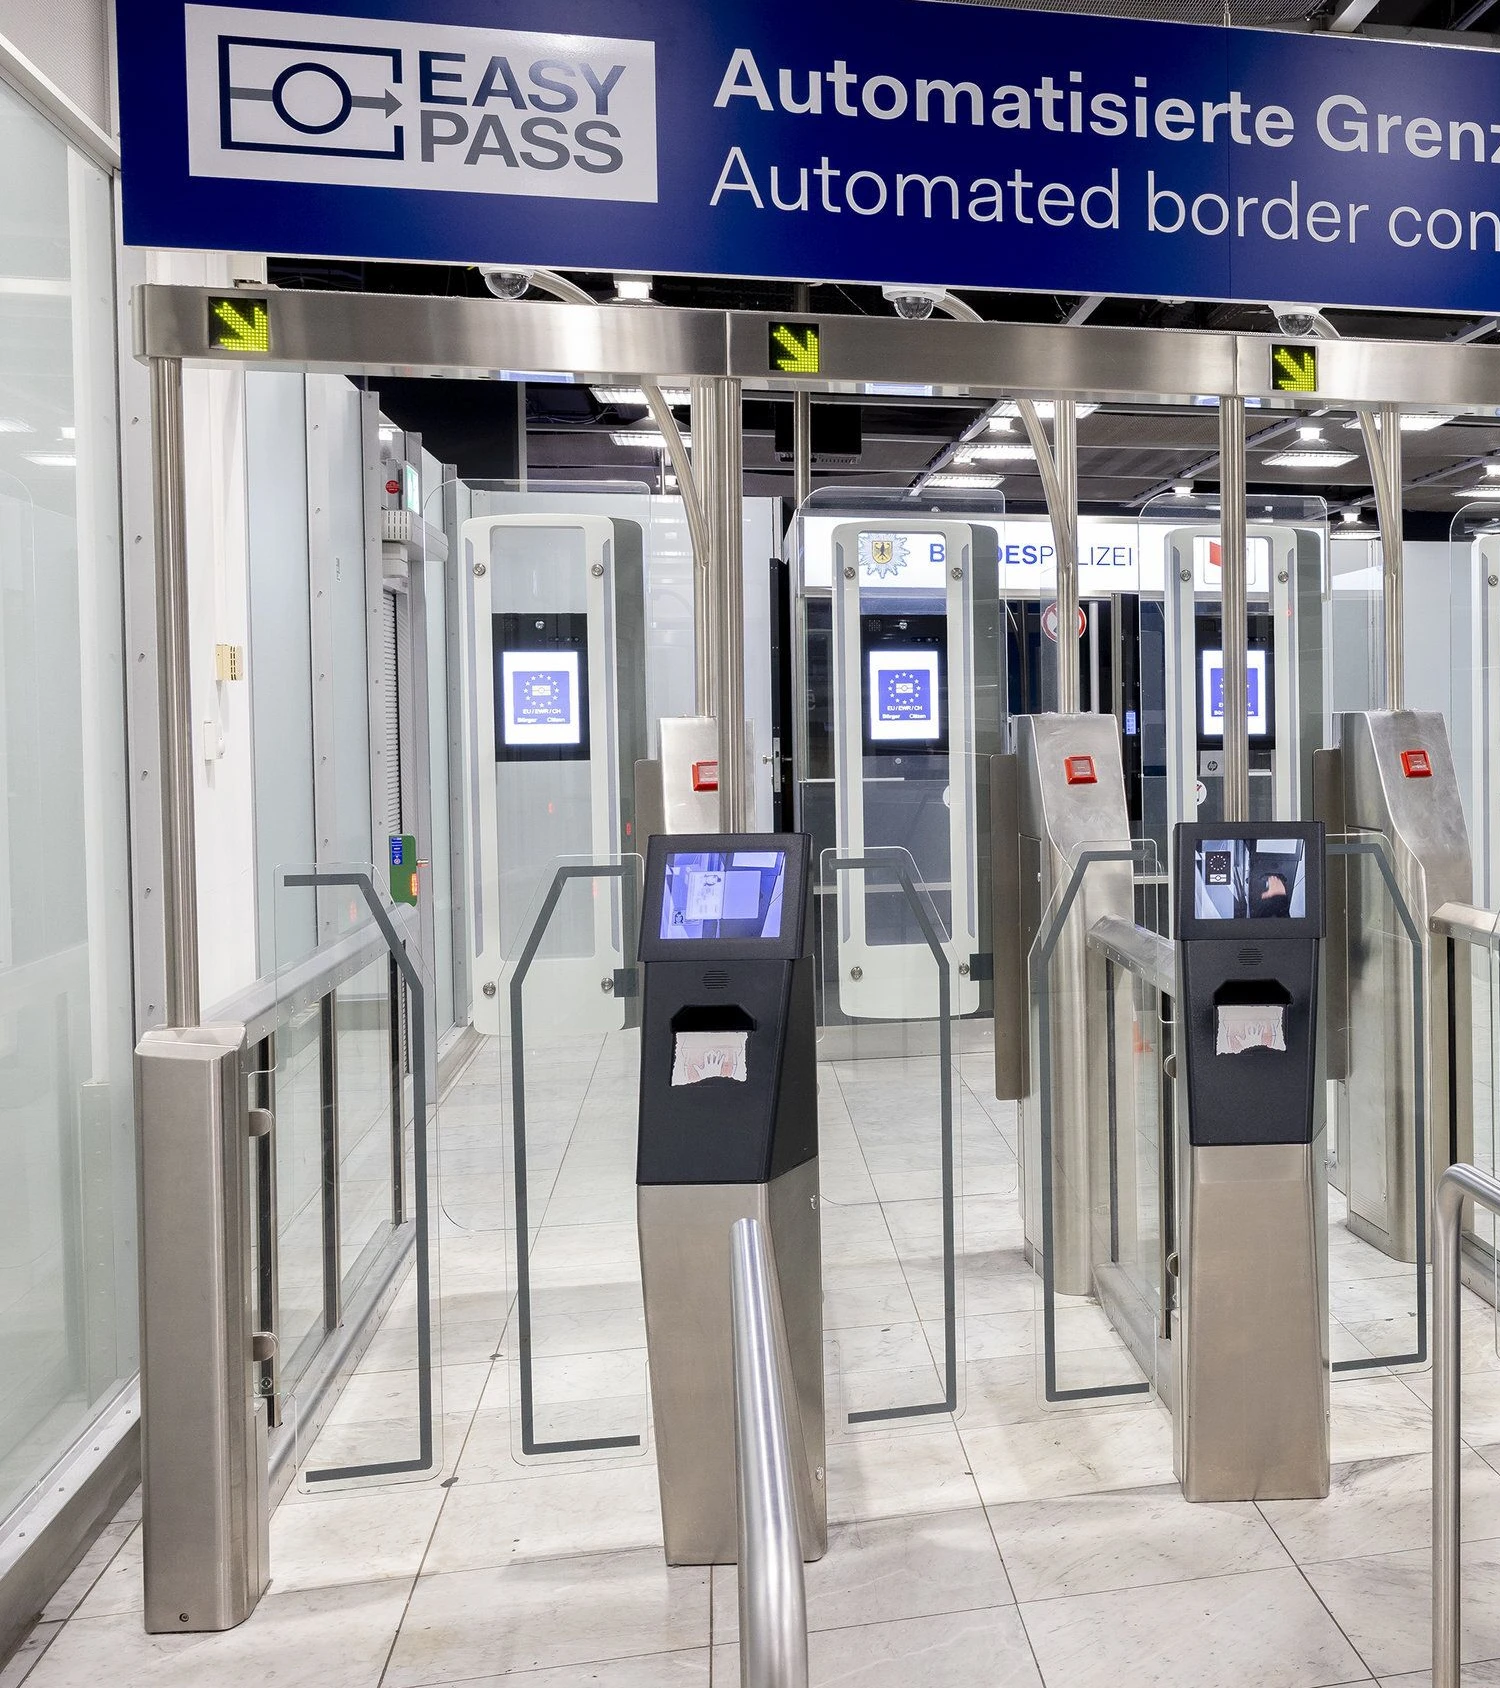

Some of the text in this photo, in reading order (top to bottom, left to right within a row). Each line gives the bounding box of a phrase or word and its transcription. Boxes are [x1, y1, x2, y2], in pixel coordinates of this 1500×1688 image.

[418, 50, 627, 117] EASY
[713, 47, 1295, 149] Automatisierte
[420, 109, 624, 174] PASS
[709, 146, 1120, 230] Automated
[1147, 169, 1370, 244] border
